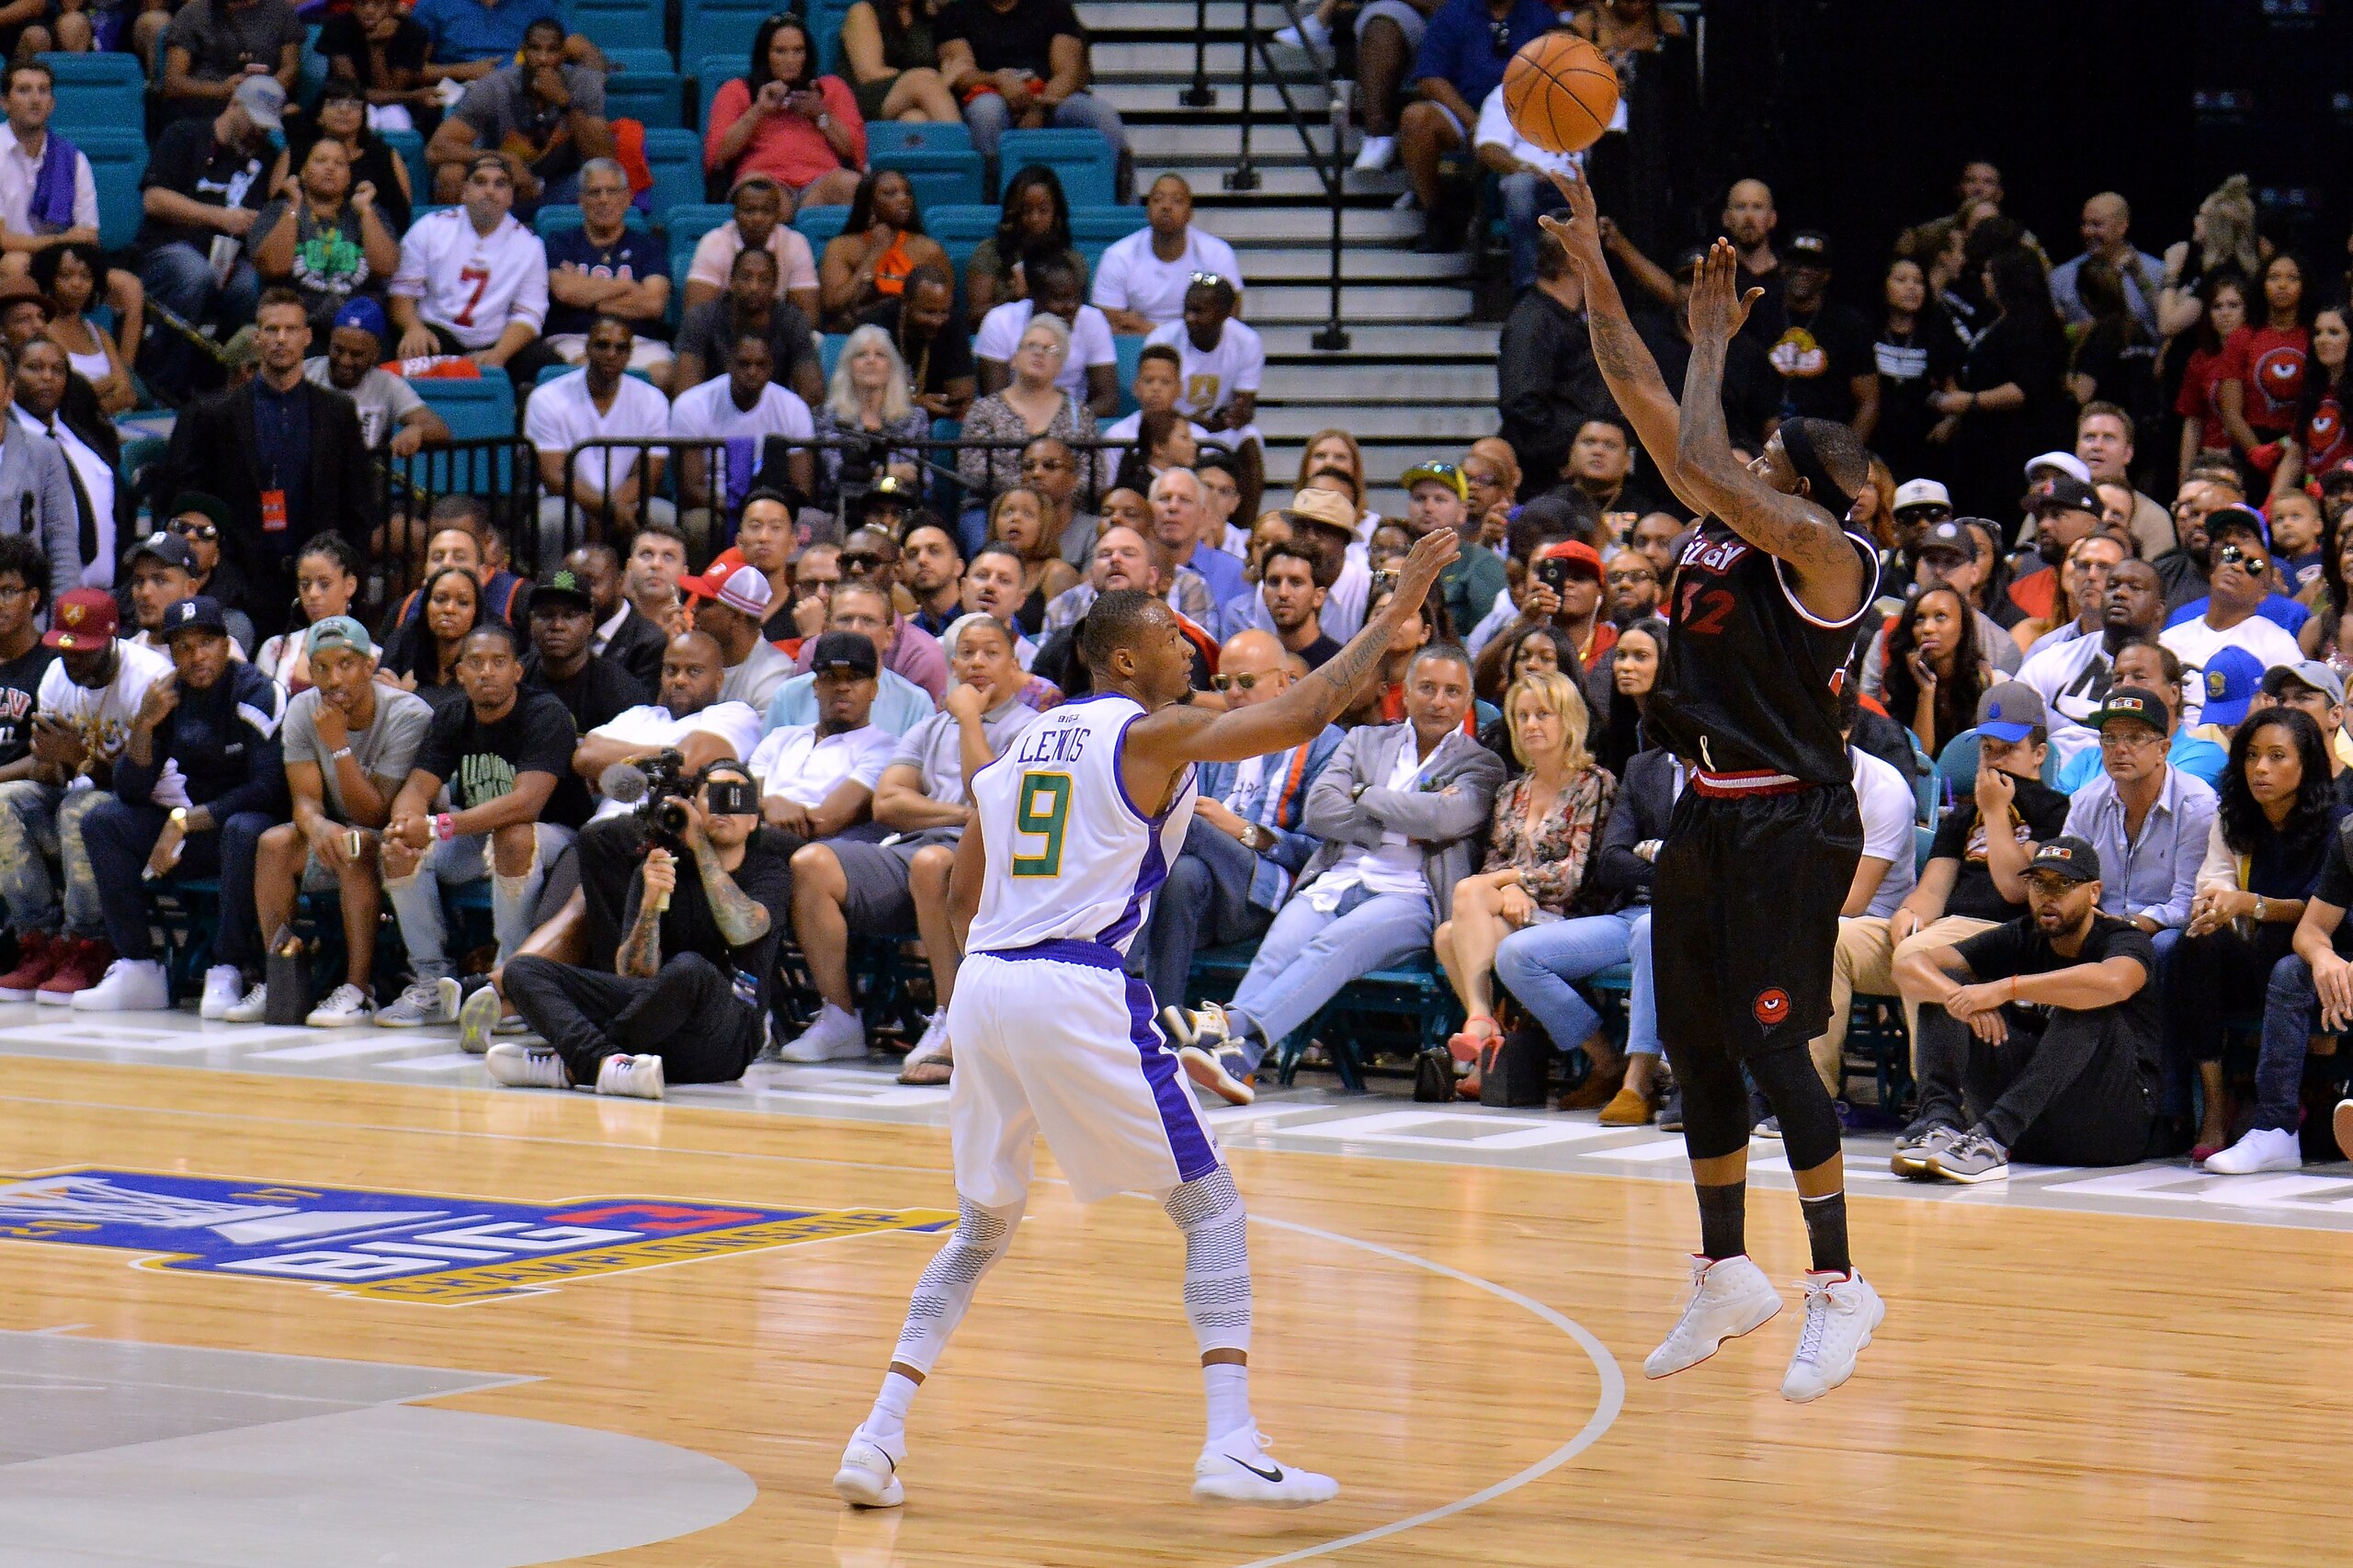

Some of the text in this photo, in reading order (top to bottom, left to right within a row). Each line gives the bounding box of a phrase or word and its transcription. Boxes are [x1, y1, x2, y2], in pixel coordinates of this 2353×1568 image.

[453, 266, 491, 327] 7
[1017, 727, 1092, 764] LEWIS
[1011, 770, 1074, 879] 9
[372, 1212, 906, 1296] CHAMPIONSHIP
